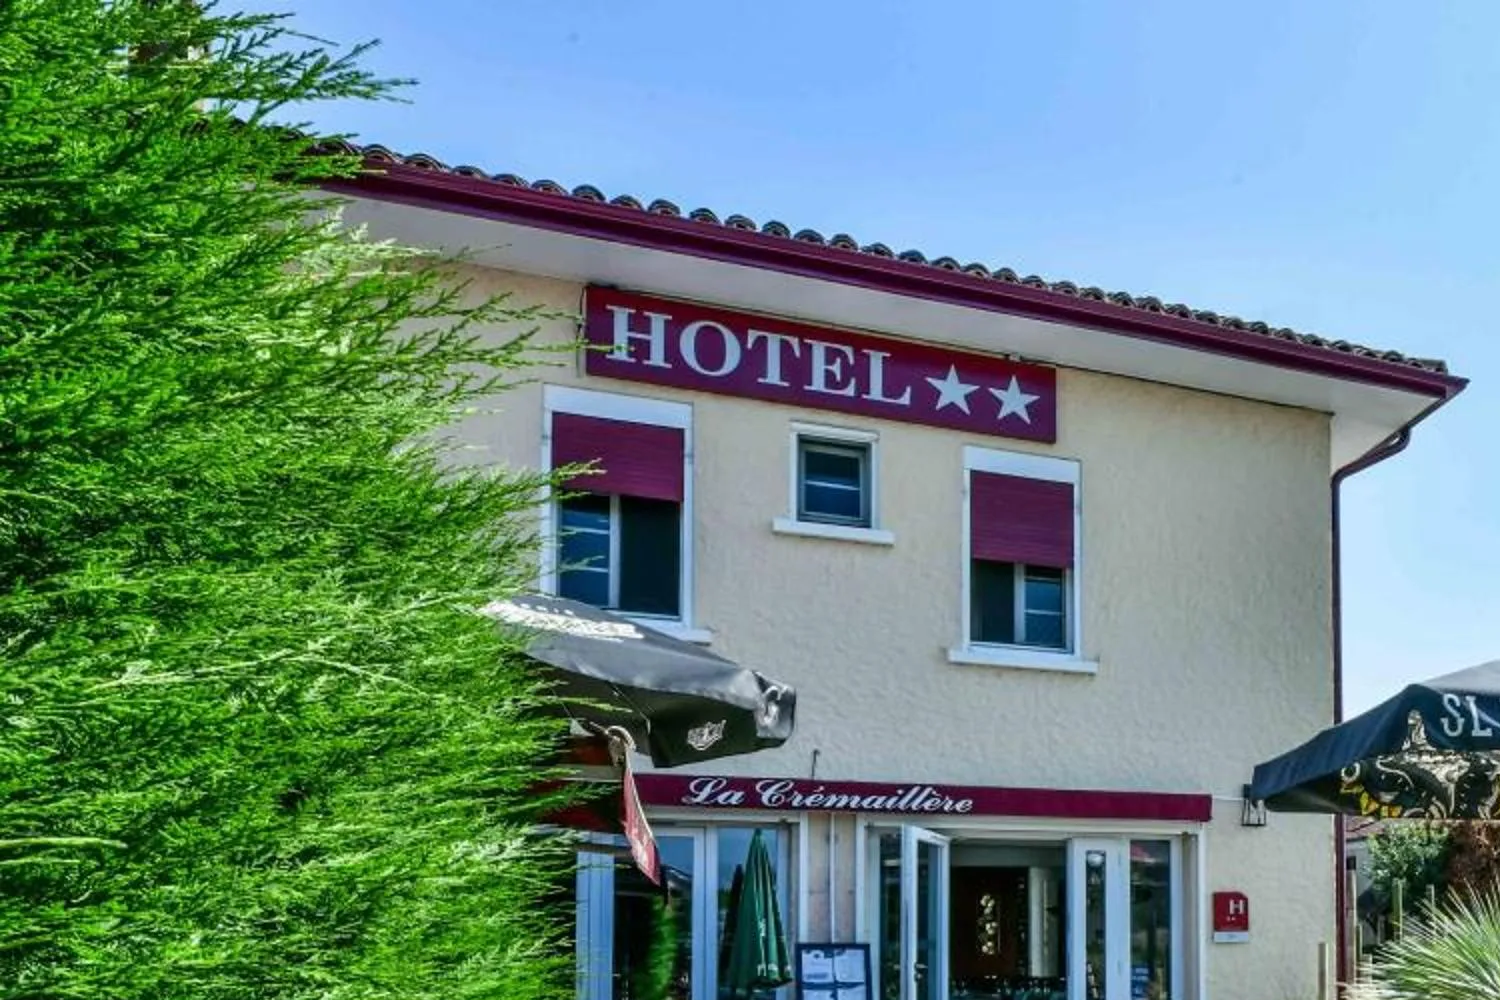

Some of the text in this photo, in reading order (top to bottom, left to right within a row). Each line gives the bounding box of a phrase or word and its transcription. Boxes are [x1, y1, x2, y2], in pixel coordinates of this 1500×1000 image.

[604, 304, 912, 407] HOTEL
[681, 777, 974, 815] La Crémaillère
[1229, 898, 1244, 915] H
